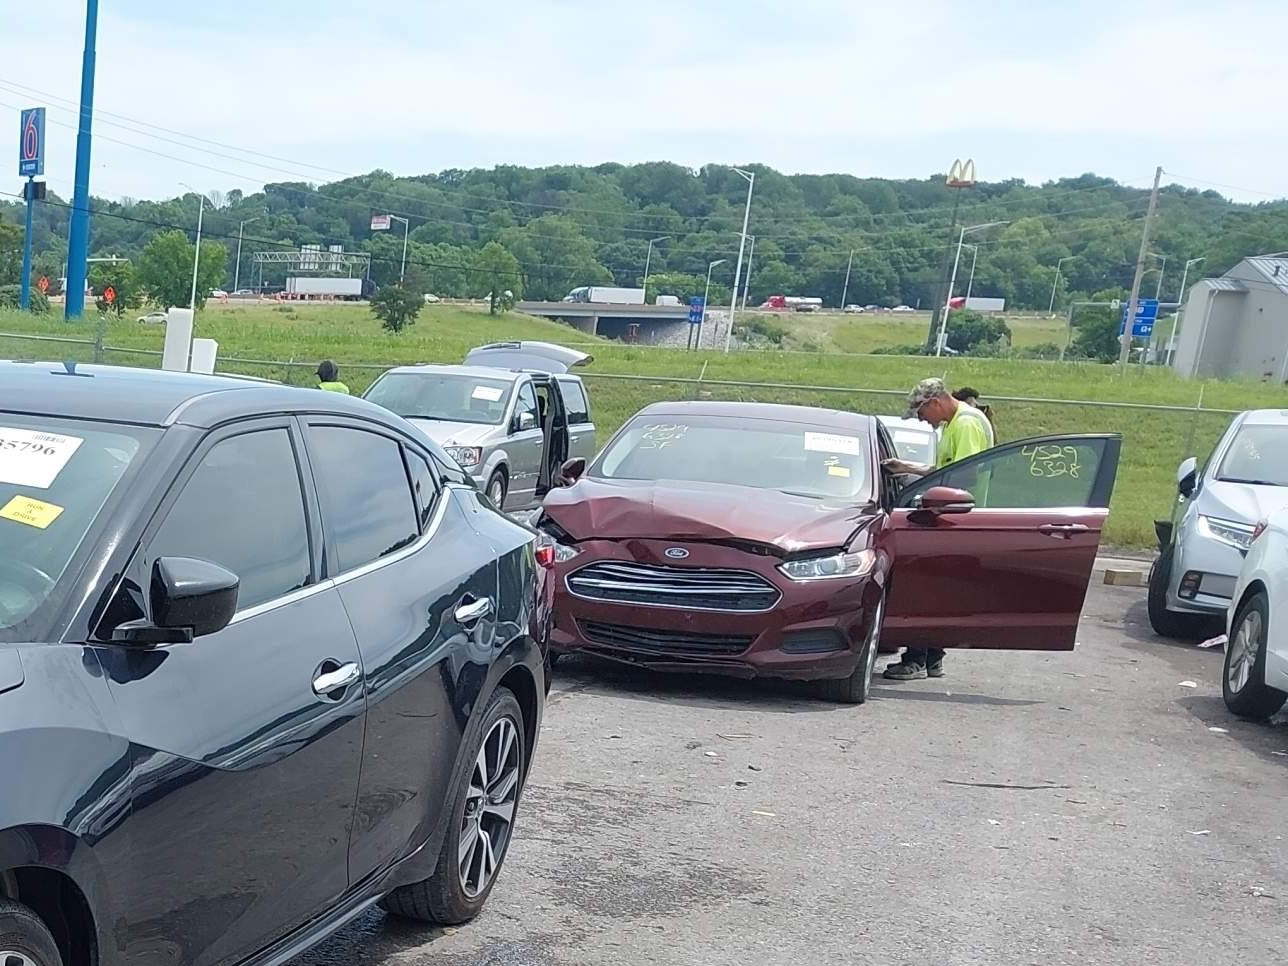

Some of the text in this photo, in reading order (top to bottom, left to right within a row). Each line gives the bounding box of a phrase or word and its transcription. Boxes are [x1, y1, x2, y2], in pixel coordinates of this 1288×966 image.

[23, 109, 38, 160] 6
[1021, 445, 1078, 466] 4529
[1030, 460, 1081, 478] 6328
